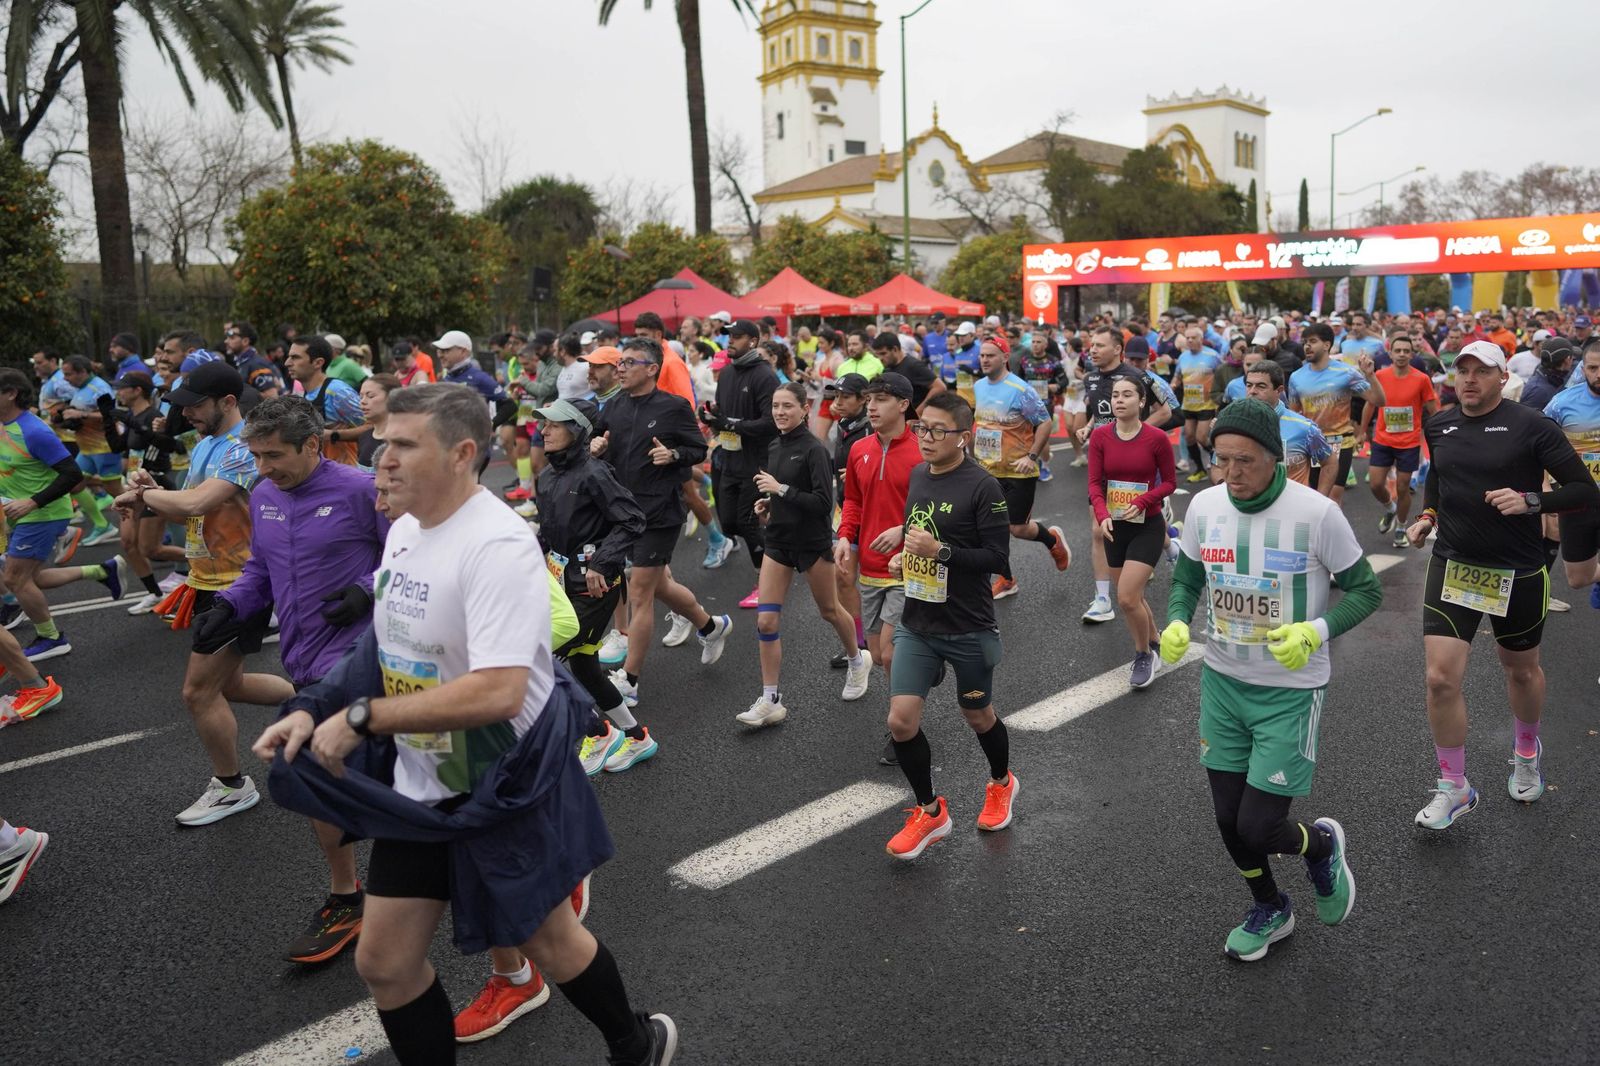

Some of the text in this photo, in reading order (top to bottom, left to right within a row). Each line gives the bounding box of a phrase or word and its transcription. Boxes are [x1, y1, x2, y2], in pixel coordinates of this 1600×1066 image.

[940, 502, 953, 514] 24
[904, 553, 938, 577] 18638
[1200, 547, 1235, 563] MARCA
[389, 572, 430, 603] Plena
[1451, 564, 1502, 590] 12923
[386, 595, 426, 620] inclusión
[1214, 588, 1270, 617] 20015
